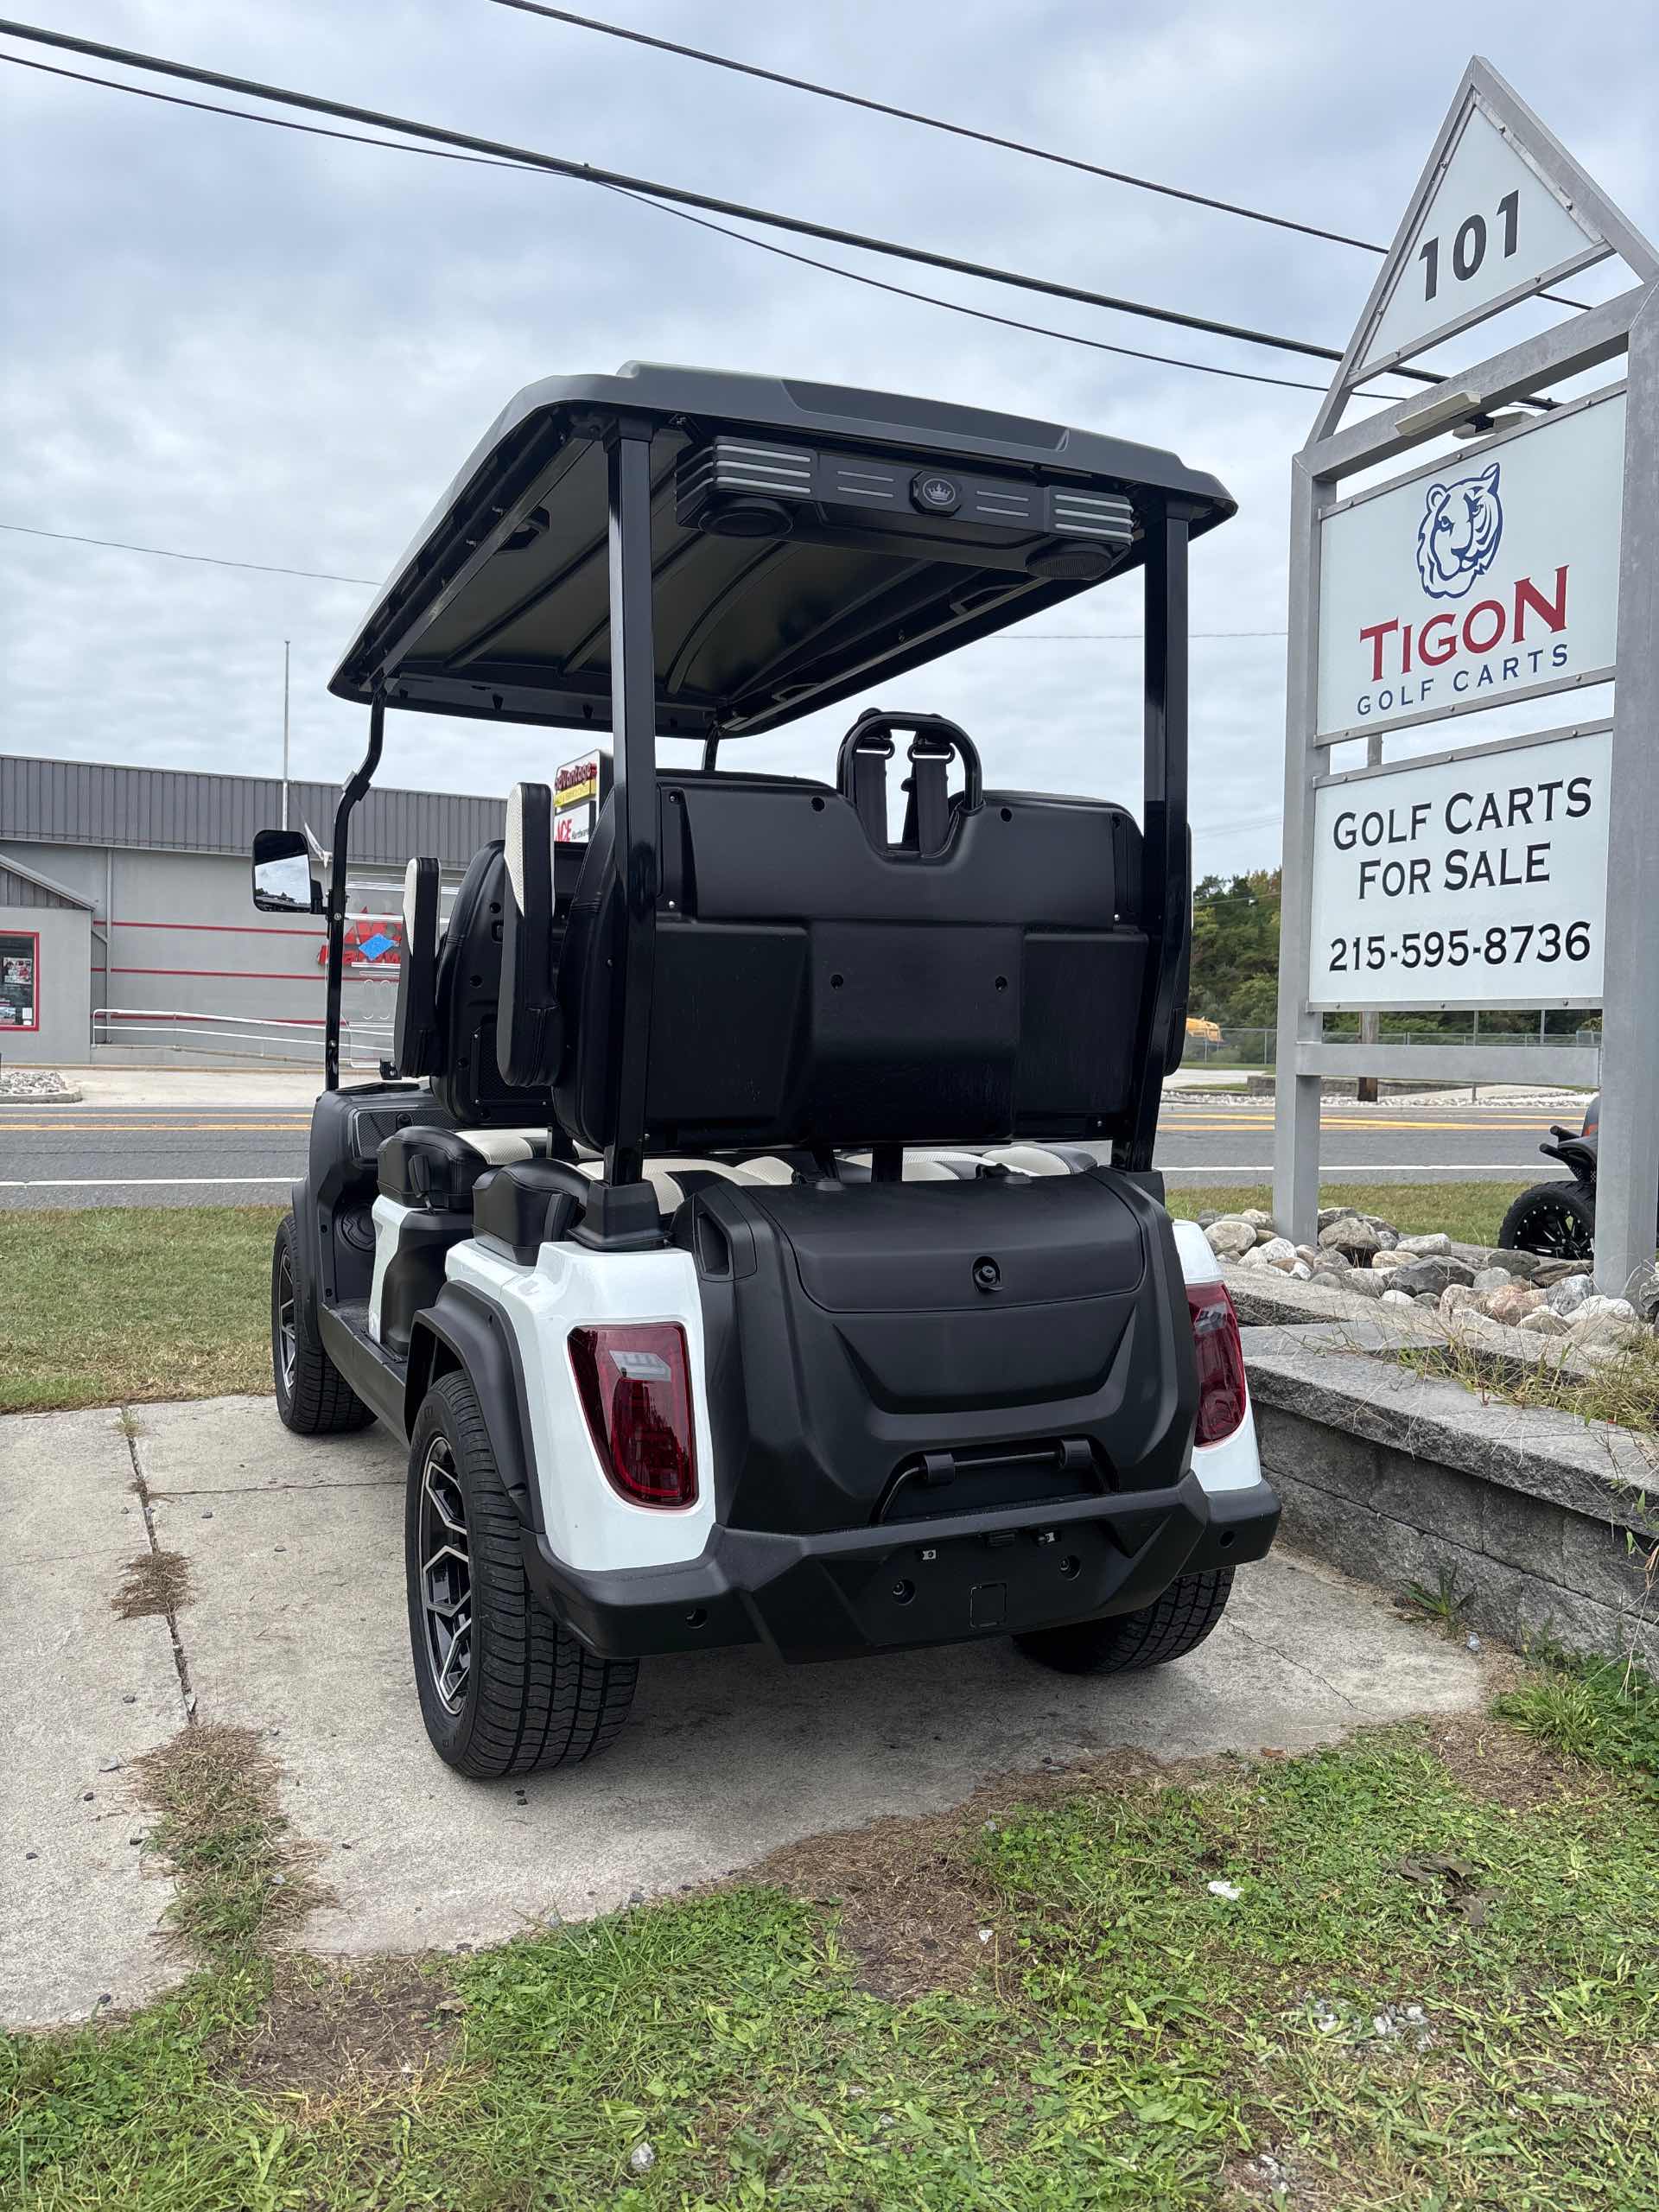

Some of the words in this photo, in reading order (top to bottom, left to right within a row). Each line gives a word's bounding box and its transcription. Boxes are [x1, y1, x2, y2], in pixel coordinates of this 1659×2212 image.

[1418, 189, 1519, 302] 101
[1359, 564, 1570, 682] TIGON
[1357, 677, 1434, 715] GOLF
[1452, 643, 1568, 692] CARTS
[1333, 802, 1432, 851] GOLF
[1445, 777, 1592, 835] CARTS
[1358, 858, 1431, 899] FOR
[1443, 841, 1551, 891] SALE
[1329, 920, 1591, 972] 215-595-8736
